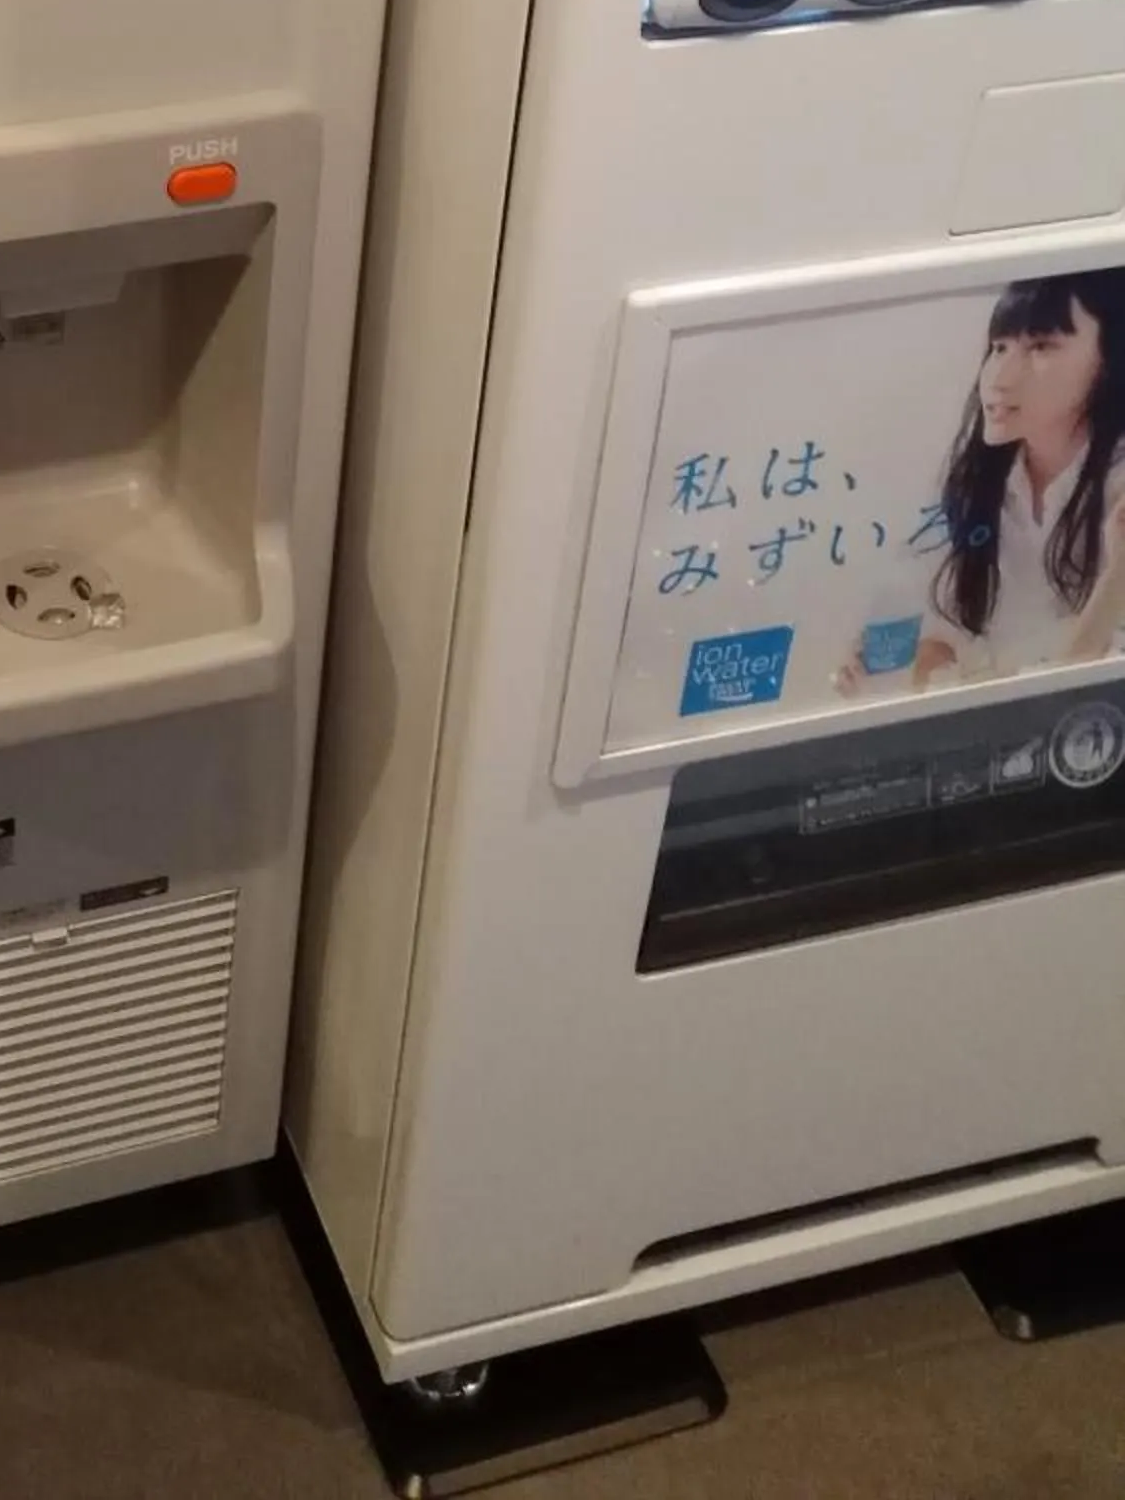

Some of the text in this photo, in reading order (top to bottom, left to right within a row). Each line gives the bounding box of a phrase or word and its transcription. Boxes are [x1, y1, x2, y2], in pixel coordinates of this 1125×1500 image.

[169, 136, 238, 164] PUSH
[670, 440, 858, 514] 私は、
[658, 502, 993, 597] みずいろ。
[692, 653, 784, 686] water
[696, 642, 743, 665] ion
